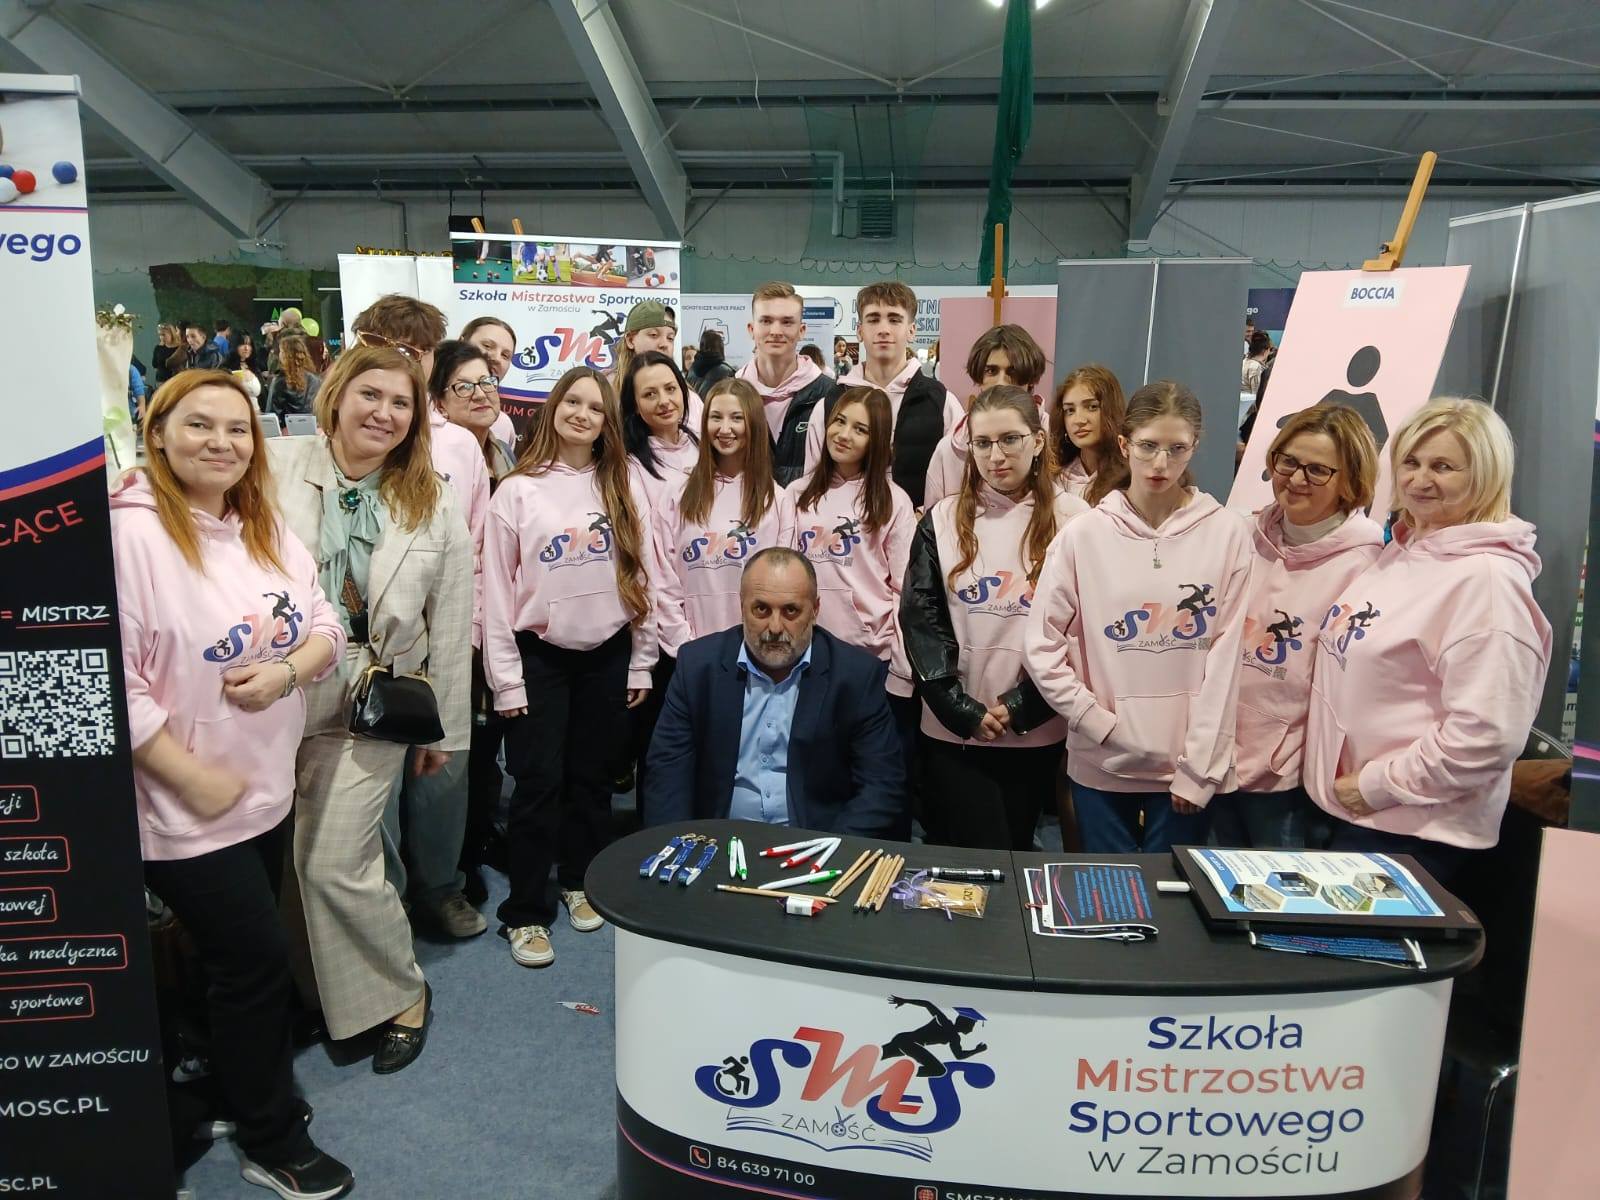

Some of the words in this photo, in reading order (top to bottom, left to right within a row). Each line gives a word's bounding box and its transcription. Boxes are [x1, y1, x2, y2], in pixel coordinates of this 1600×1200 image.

[0, 232, 81, 262] ego
[459, 289, 507, 302] Szkoła
[511, 290, 595, 304] Mistrzostwa
[599, 293, 678, 307] Sportowego
[1351, 287, 1395, 300] BOCCIA
[538, 304, 581, 313] Zamościu
[22, 604, 110, 622] MISTRZ
[4, 842, 59, 861] szkoła
[29, 942, 118, 966] medyczna
[10, 994, 84, 1017] sportowe
[1147, 1015, 1303, 1050] Szkoła
[0, 1056, 19, 1070] O
[24, 1055, 44, 1069] W
[48, 1048, 149, 1068] ZAMOŚCIU
[695, 1027, 996, 1134] SMS
[1076, 1058, 1366, 1094] Mistrzostwa
[0, 1096, 109, 1118] MOSC.PL
[781, 1106, 876, 1142] ZAMOŚĆ
[1068, 1101, 1365, 1143] Sportowego
[717, 1157, 738, 1171] 84
[741, 1162, 770, 1177] 639
[773, 1168, 789, 1181] 71
[793, 1172, 815, 1185] 00
[1088, 1151, 1125, 1172] w
[1137, 1146, 1338, 1175] Zamościu
